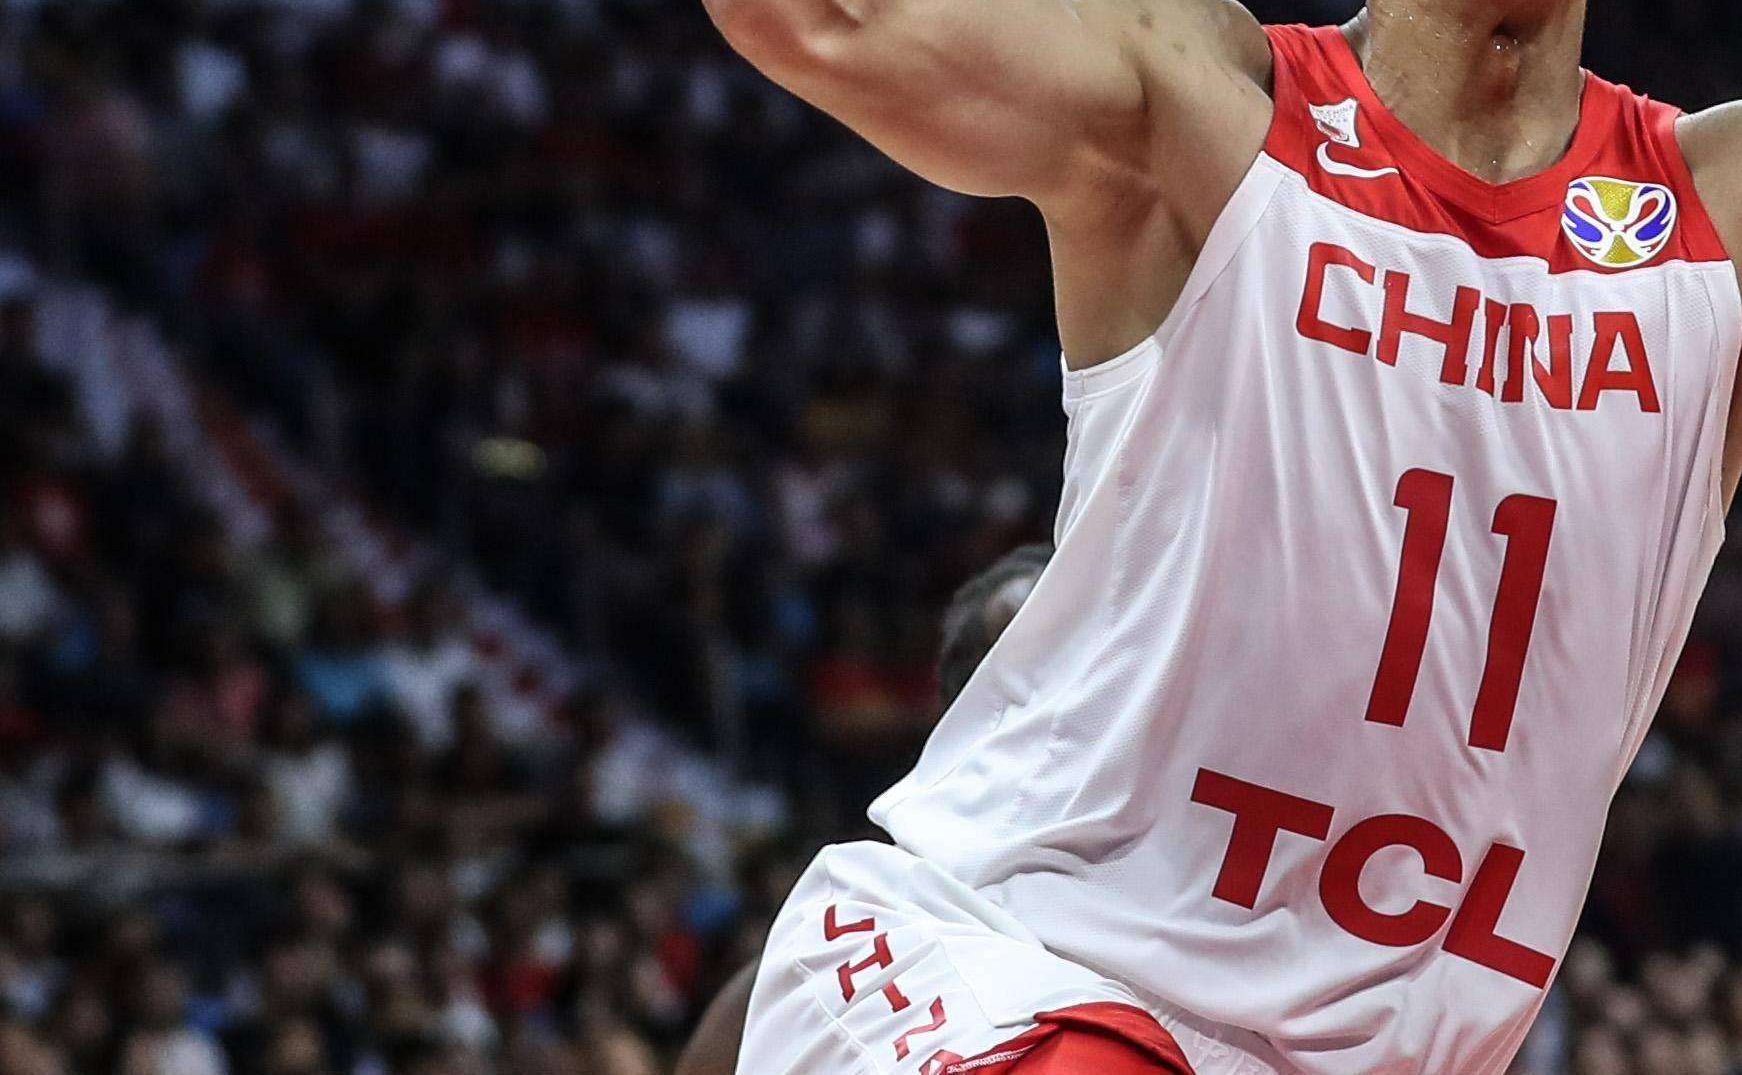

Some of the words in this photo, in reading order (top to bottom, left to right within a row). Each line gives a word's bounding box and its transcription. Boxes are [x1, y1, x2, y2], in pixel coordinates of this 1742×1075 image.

[1296, 242, 1661, 414] CHINA
[1364, 467, 1557, 753] 11
[1190, 767, 1557, 990] TCL
